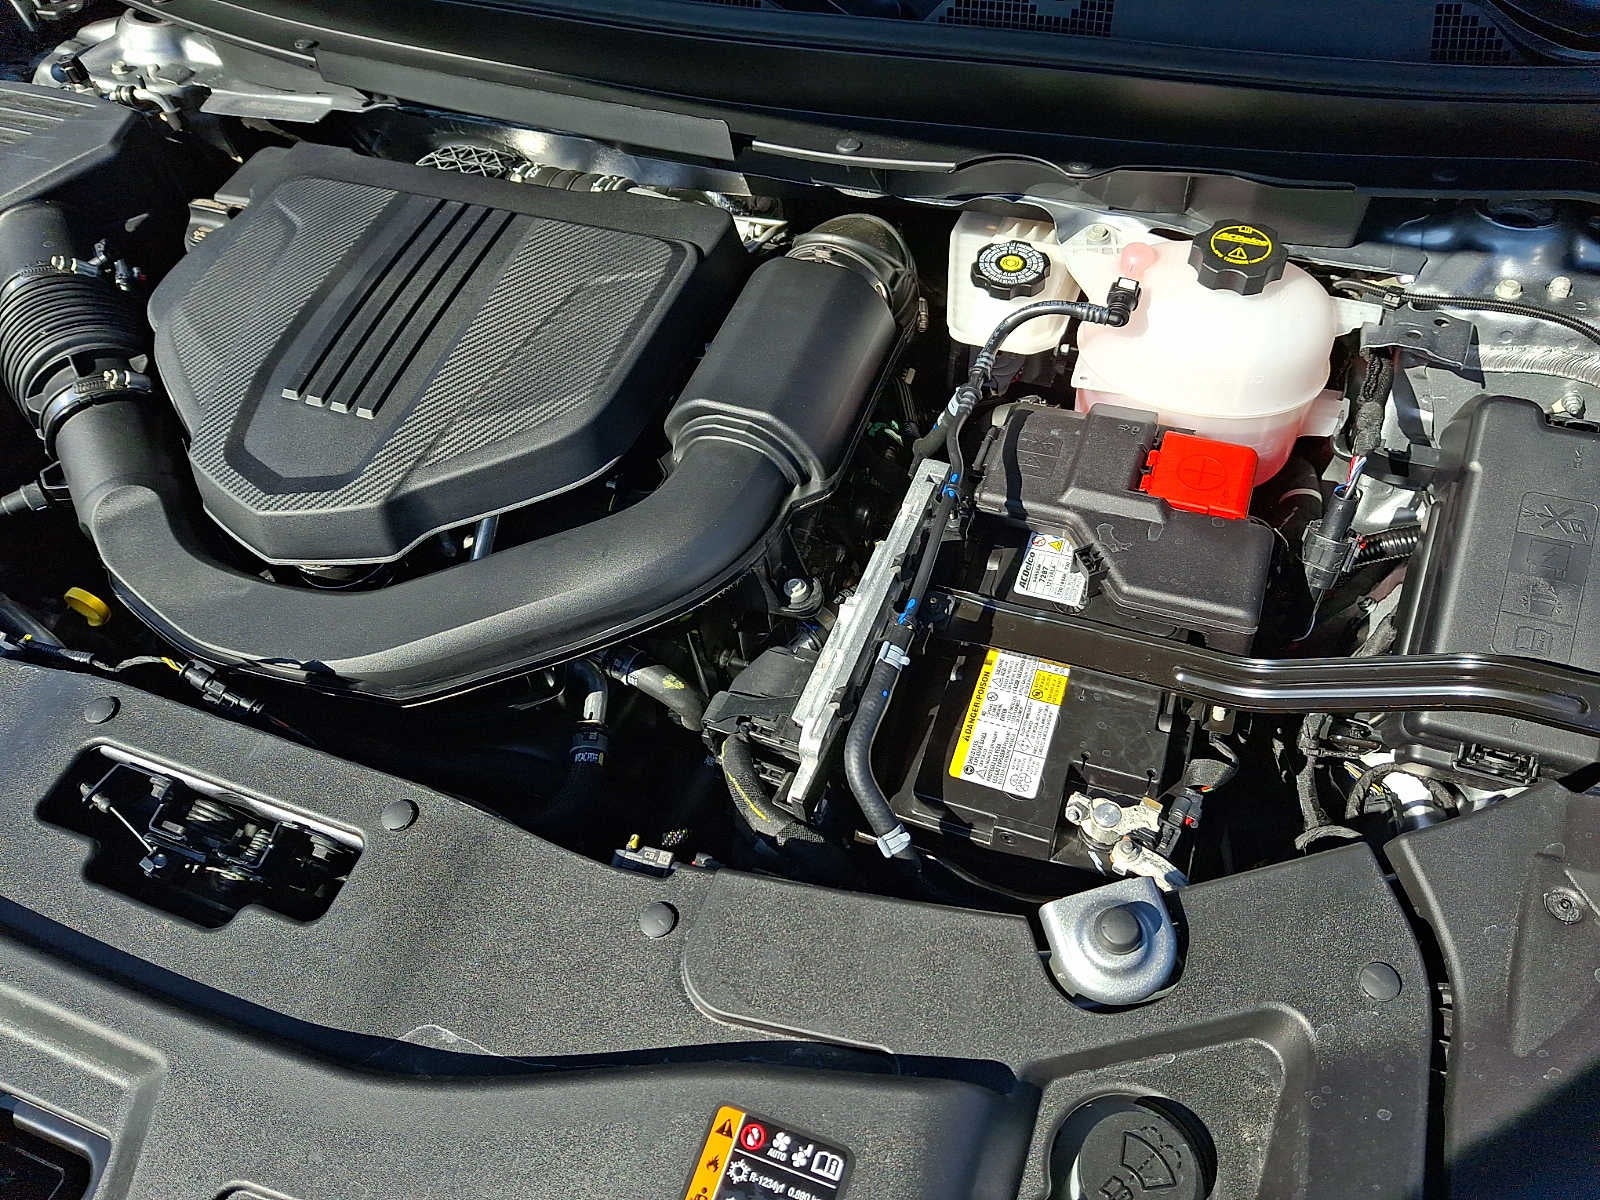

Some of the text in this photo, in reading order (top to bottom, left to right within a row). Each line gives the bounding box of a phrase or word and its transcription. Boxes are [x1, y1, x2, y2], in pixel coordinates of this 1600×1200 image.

[1019, 551, 1036, 588] ACDelco
[965, 671, 991, 735] DANGER/POISON
[766, 1147, 787, 1161] AUTO
[749, 1172, 786, 1194] R-1234yf
